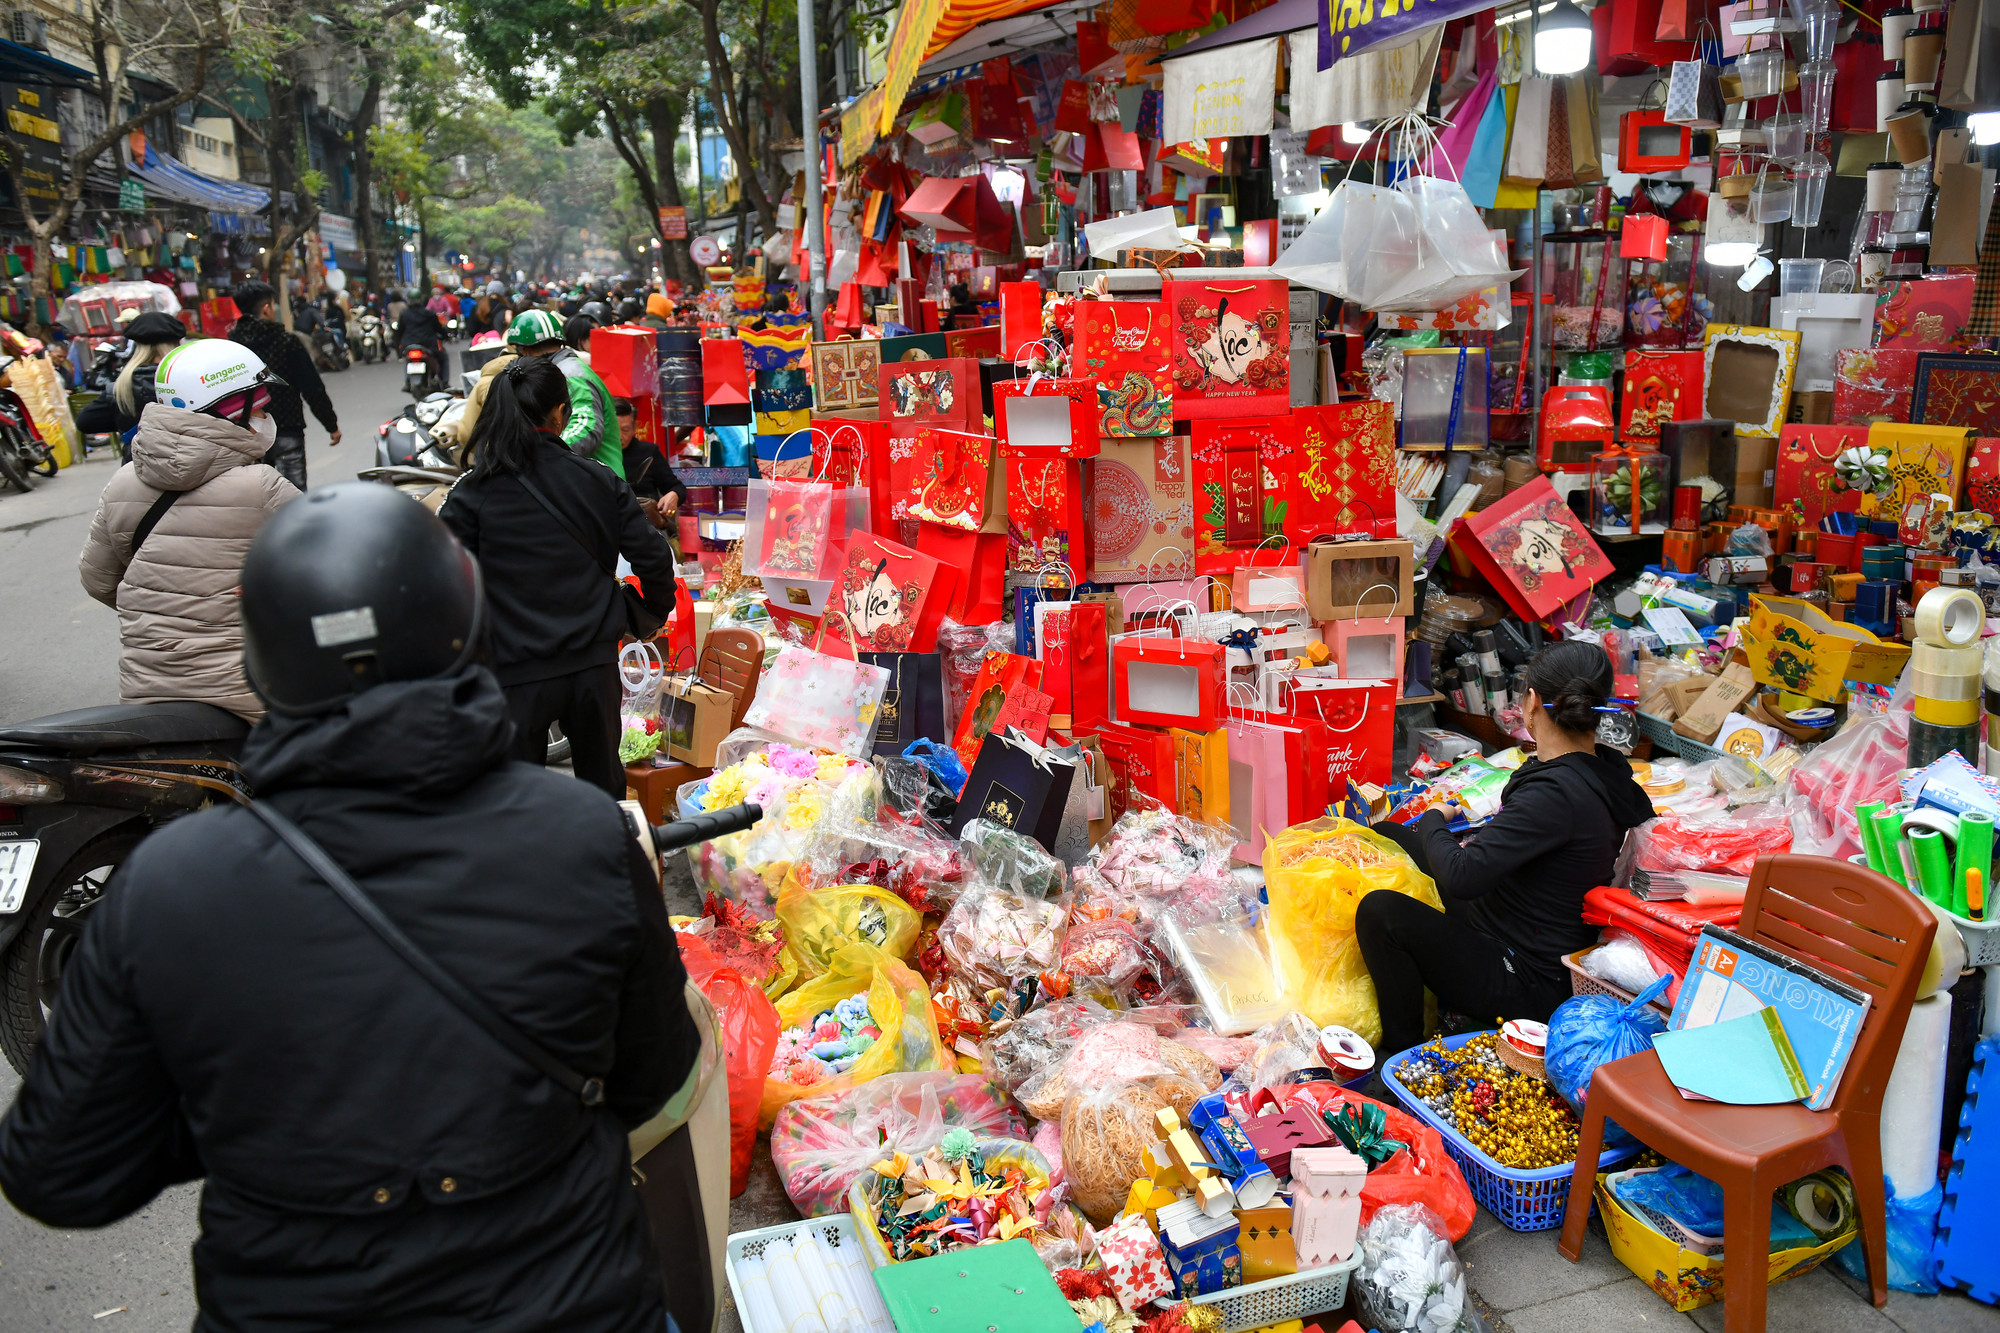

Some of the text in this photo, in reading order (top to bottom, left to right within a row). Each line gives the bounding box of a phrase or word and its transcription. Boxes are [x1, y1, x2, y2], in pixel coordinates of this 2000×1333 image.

[1155, 481, 1185, 491] Happy
[1166, 490, 1186, 499] Year
[1822, 1008, 1855, 1080] Composition Book
